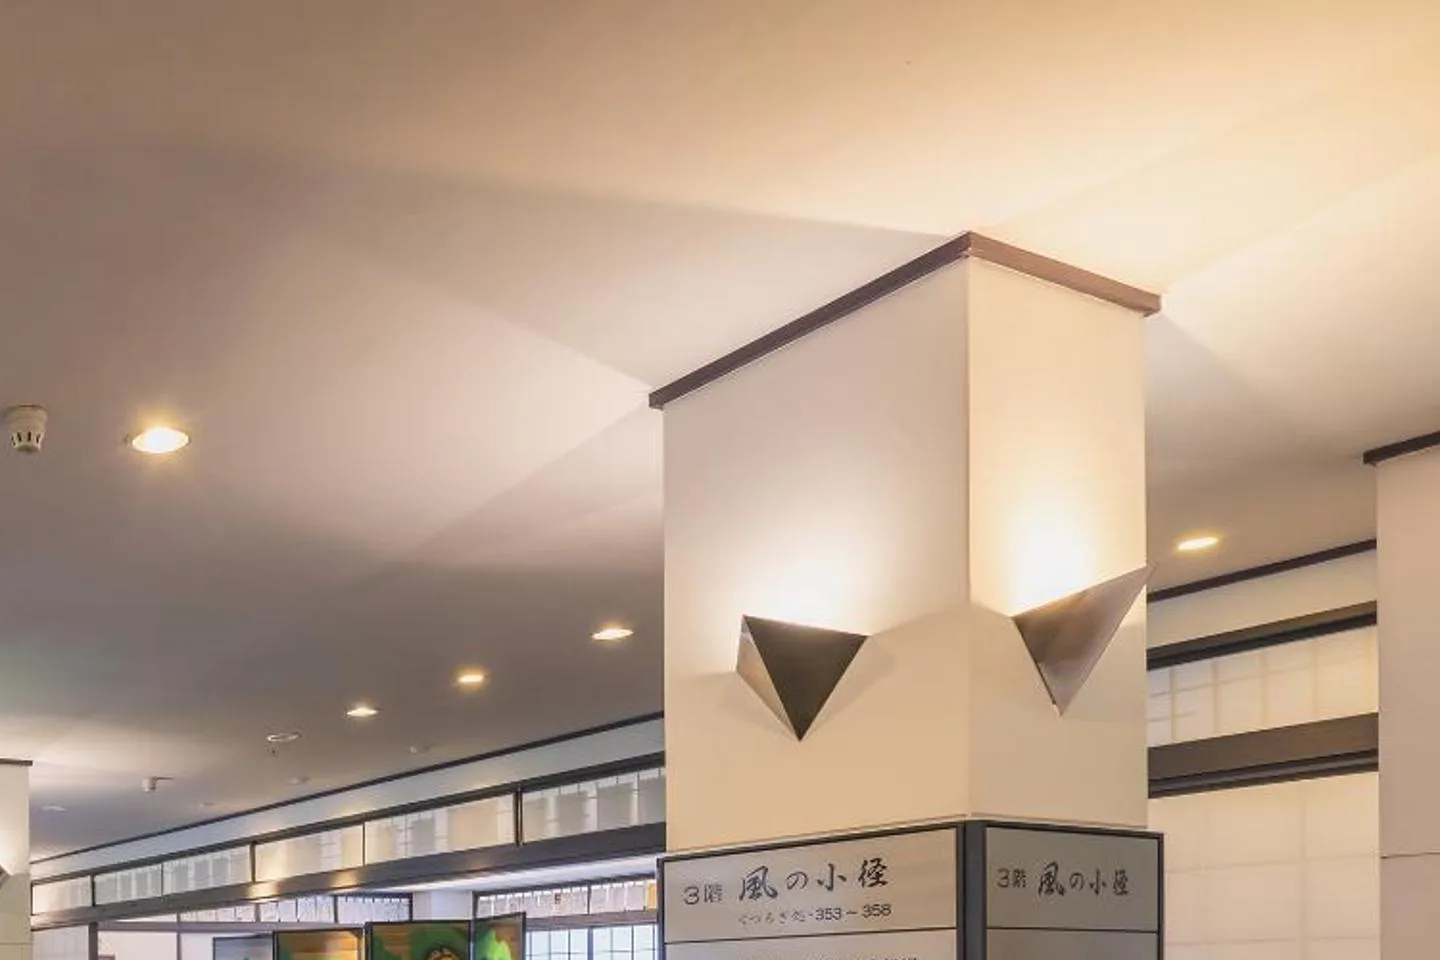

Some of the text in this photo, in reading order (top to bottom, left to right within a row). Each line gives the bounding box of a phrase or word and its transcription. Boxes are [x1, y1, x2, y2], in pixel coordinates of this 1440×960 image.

[683, 857, 890, 905] 3階 風の小径
[997, 861, 1129, 896] 3階 風の小径
